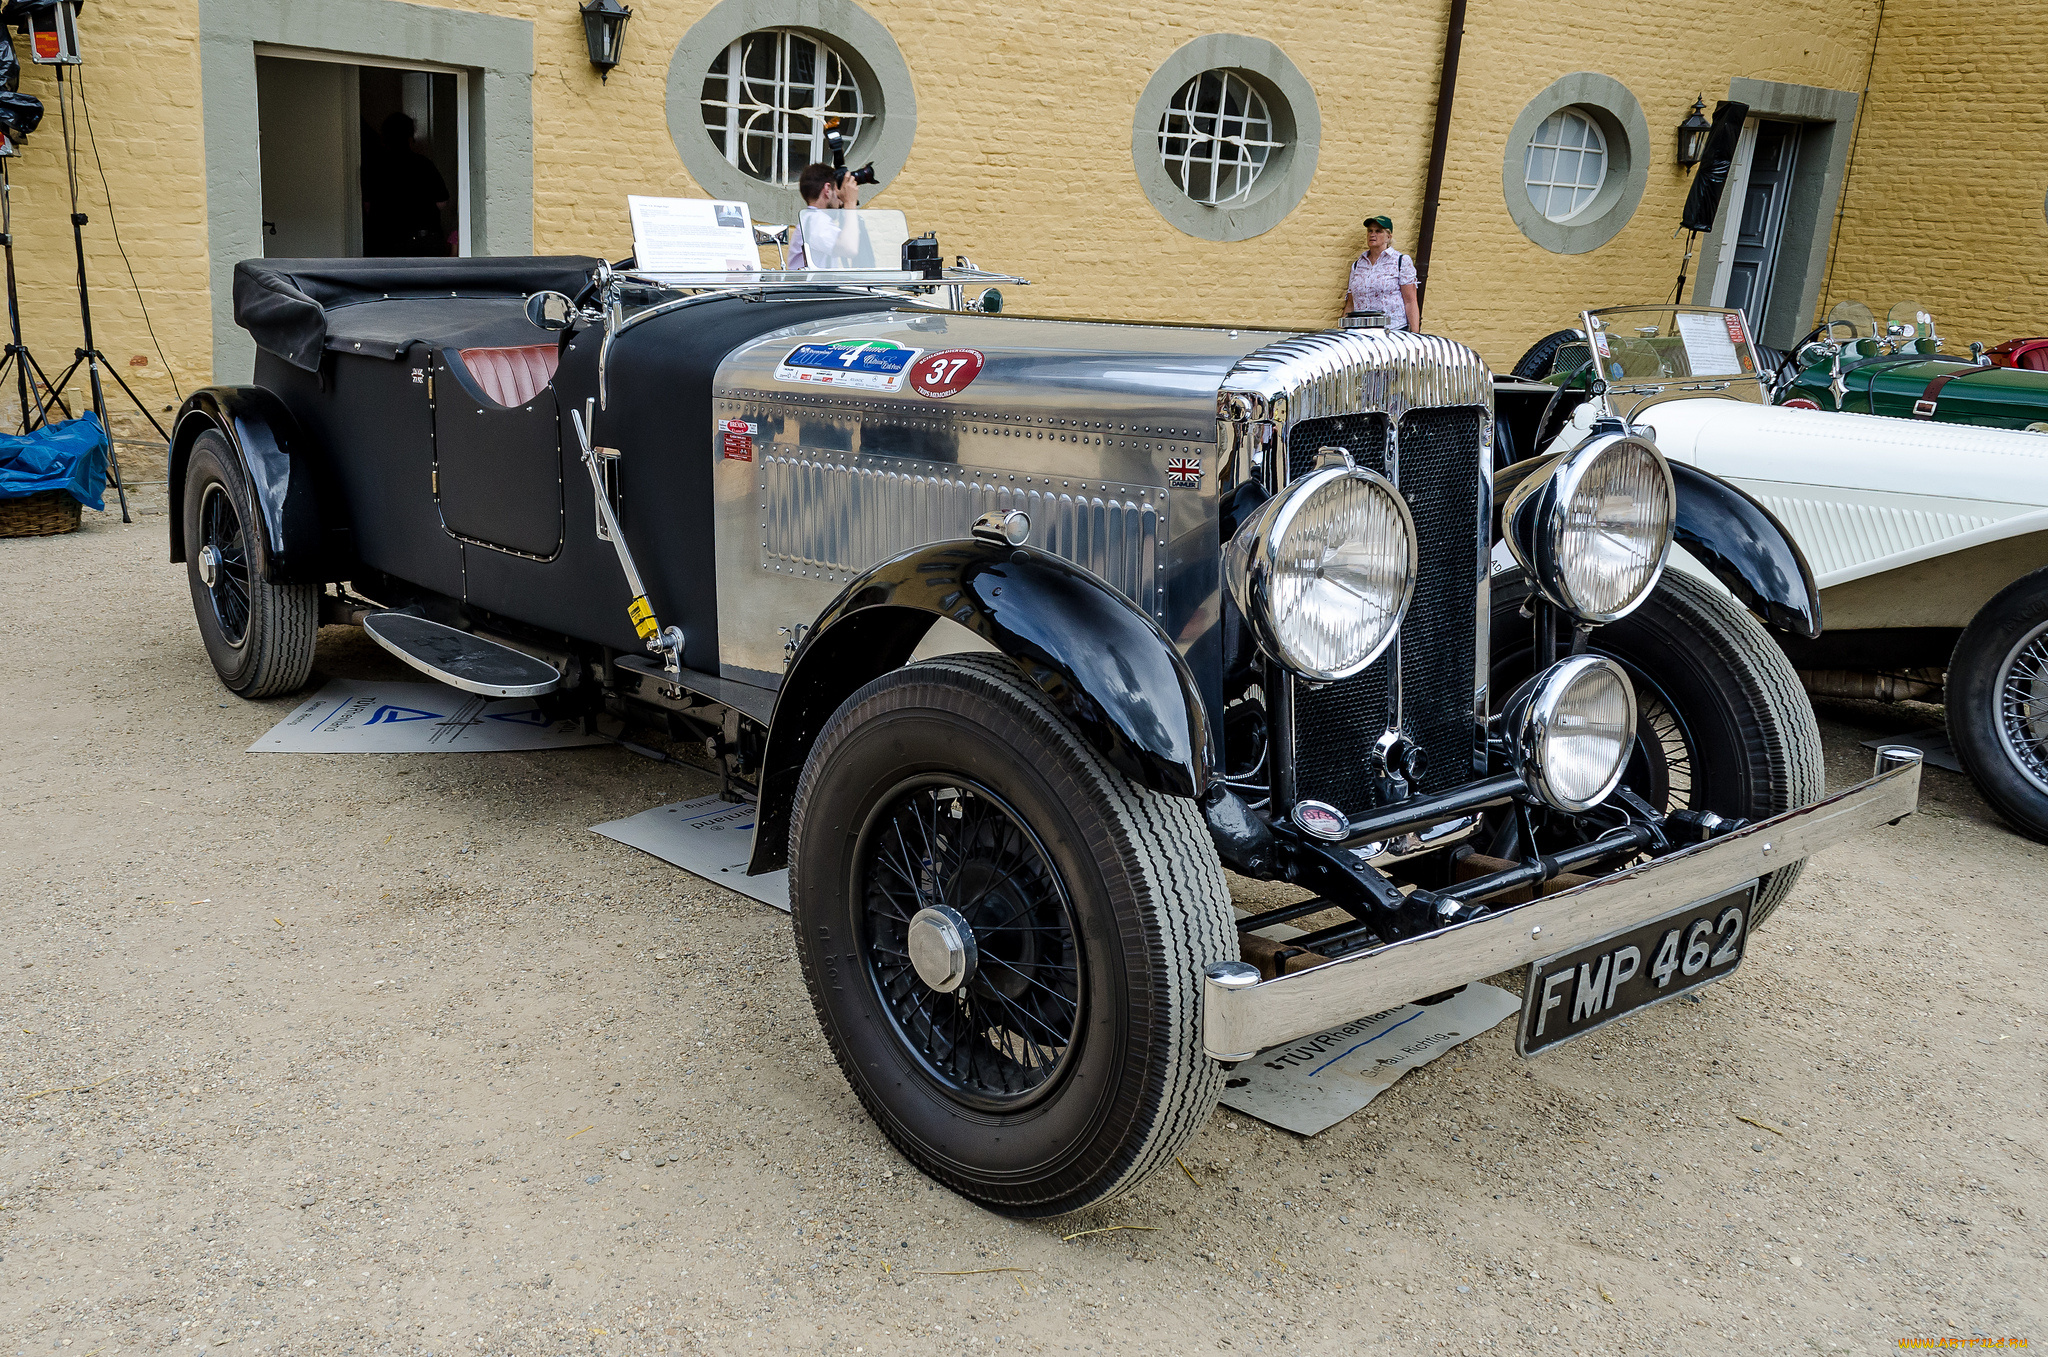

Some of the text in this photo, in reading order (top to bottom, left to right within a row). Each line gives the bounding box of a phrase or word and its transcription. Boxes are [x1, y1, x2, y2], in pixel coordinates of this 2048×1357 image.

[839, 341, 874, 367] 4
[925, 358, 968, 385] 37
[691, 807, 757, 829] einland
[1535, 907, 1744, 1037] FMP 462
